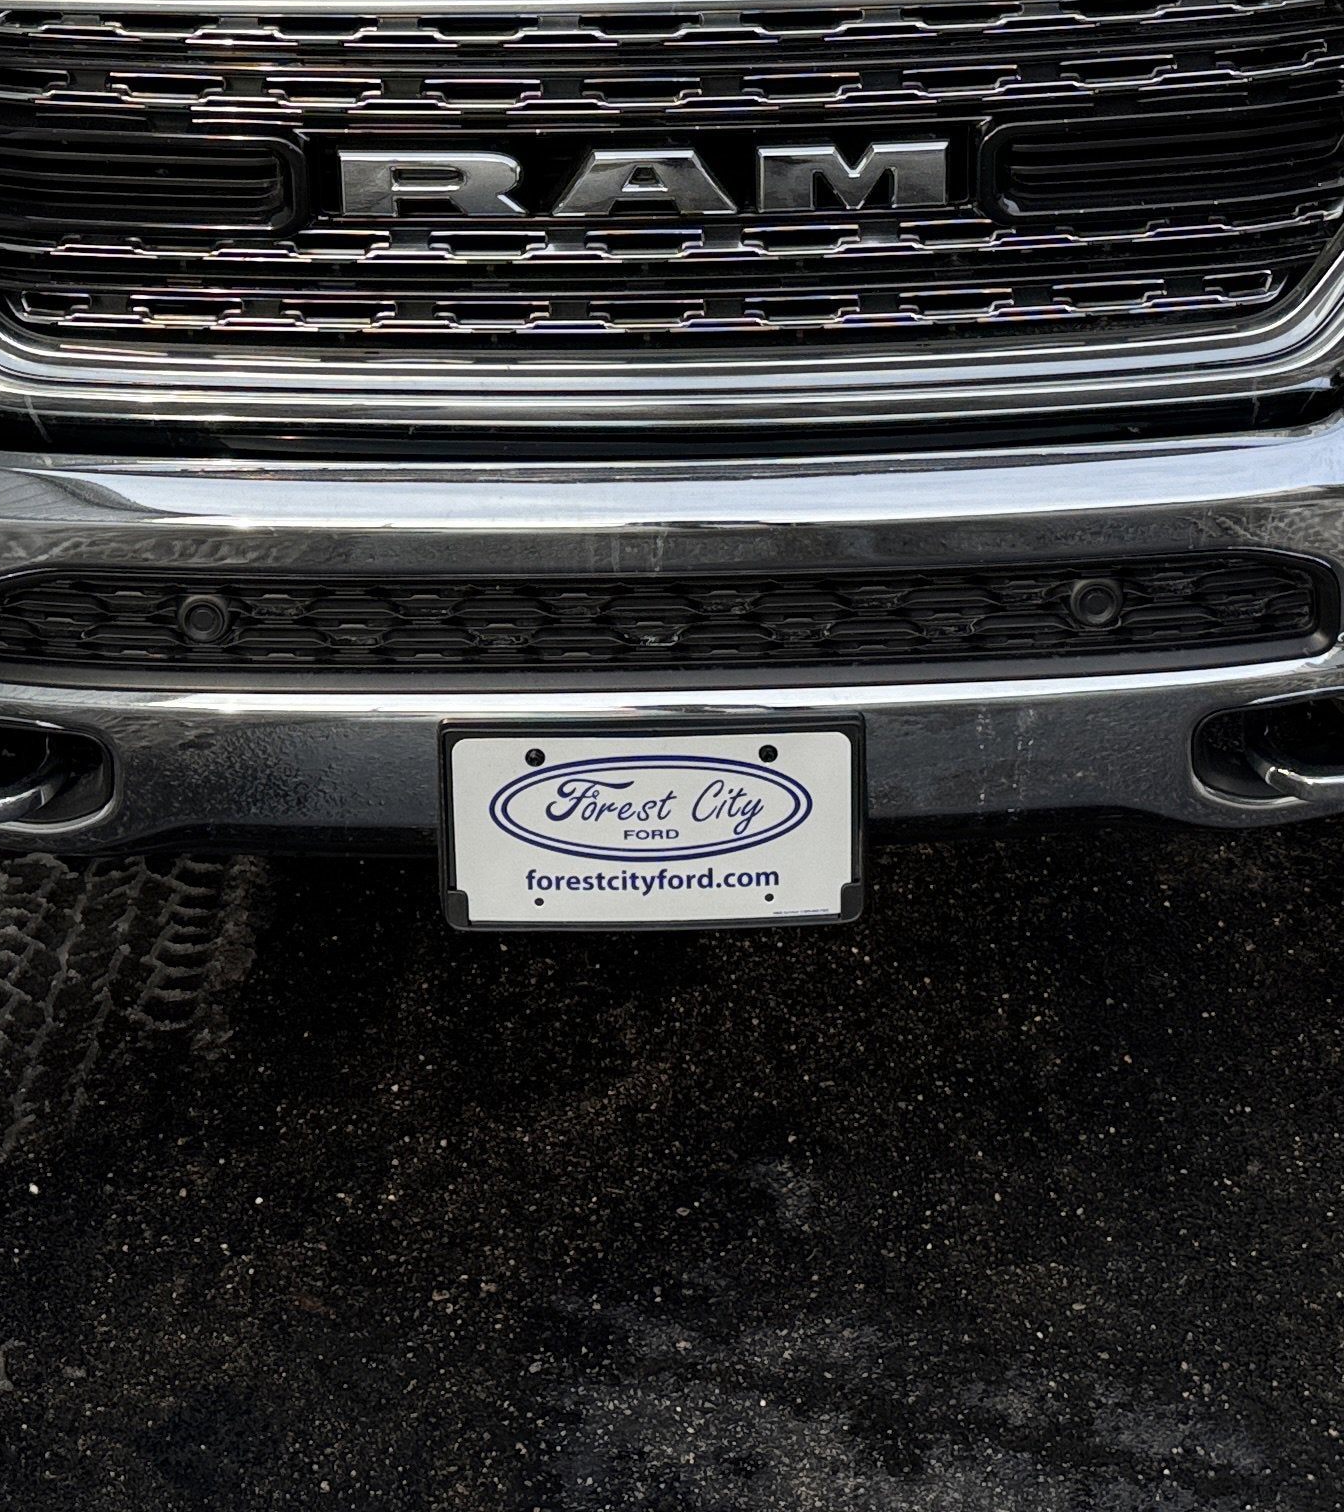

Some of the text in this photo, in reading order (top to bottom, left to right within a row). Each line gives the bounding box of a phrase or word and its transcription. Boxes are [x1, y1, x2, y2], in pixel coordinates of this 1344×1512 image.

[338, 142, 949, 216] RAM
[545, 779, 765, 835] Forest City
[623, 829, 680, 841] FORD
[525, 867, 780, 896] forestcityford.com
